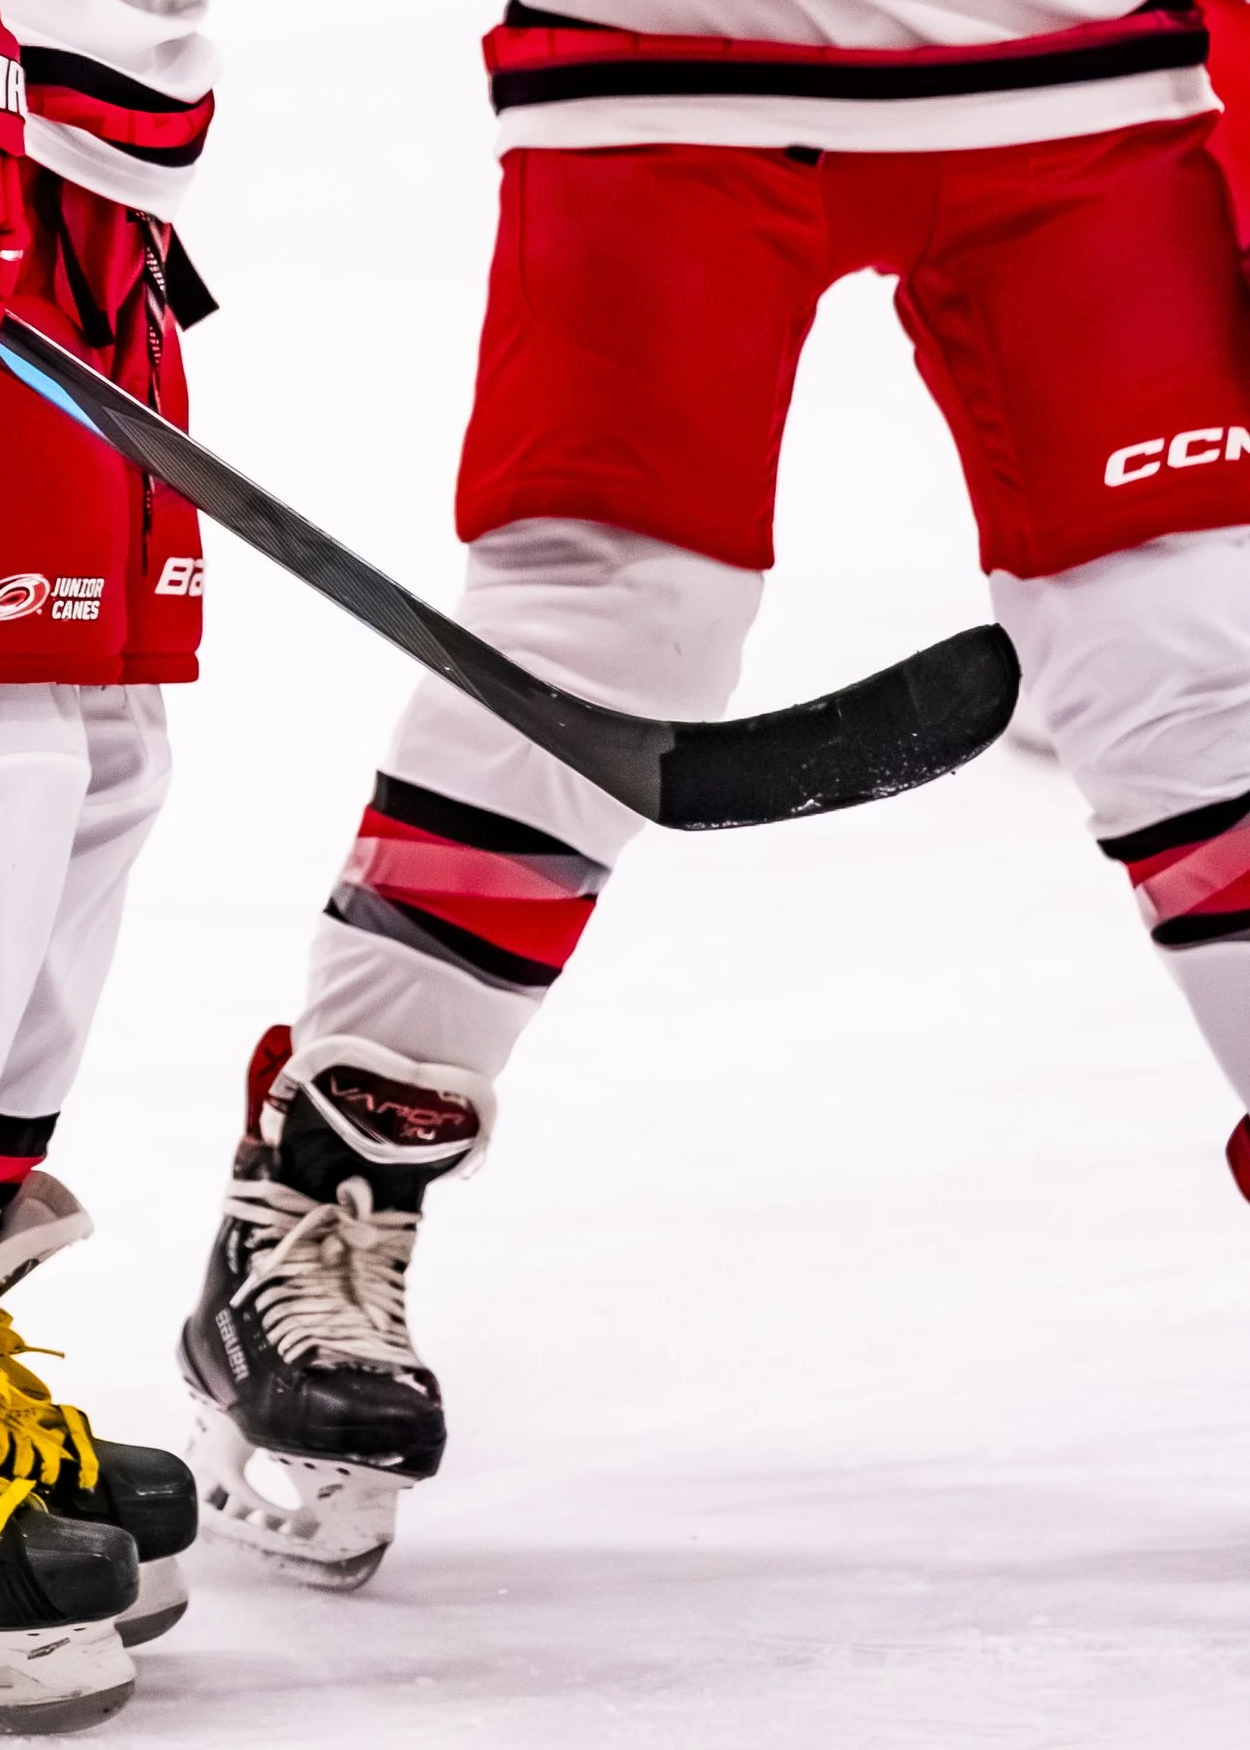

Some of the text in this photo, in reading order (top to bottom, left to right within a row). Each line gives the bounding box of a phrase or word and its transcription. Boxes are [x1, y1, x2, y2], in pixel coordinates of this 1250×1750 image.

[51, 577, 105, 597] JUNIOR
[52, 601, 100, 620] CANES
[215, 1307, 249, 1383] BAUER
